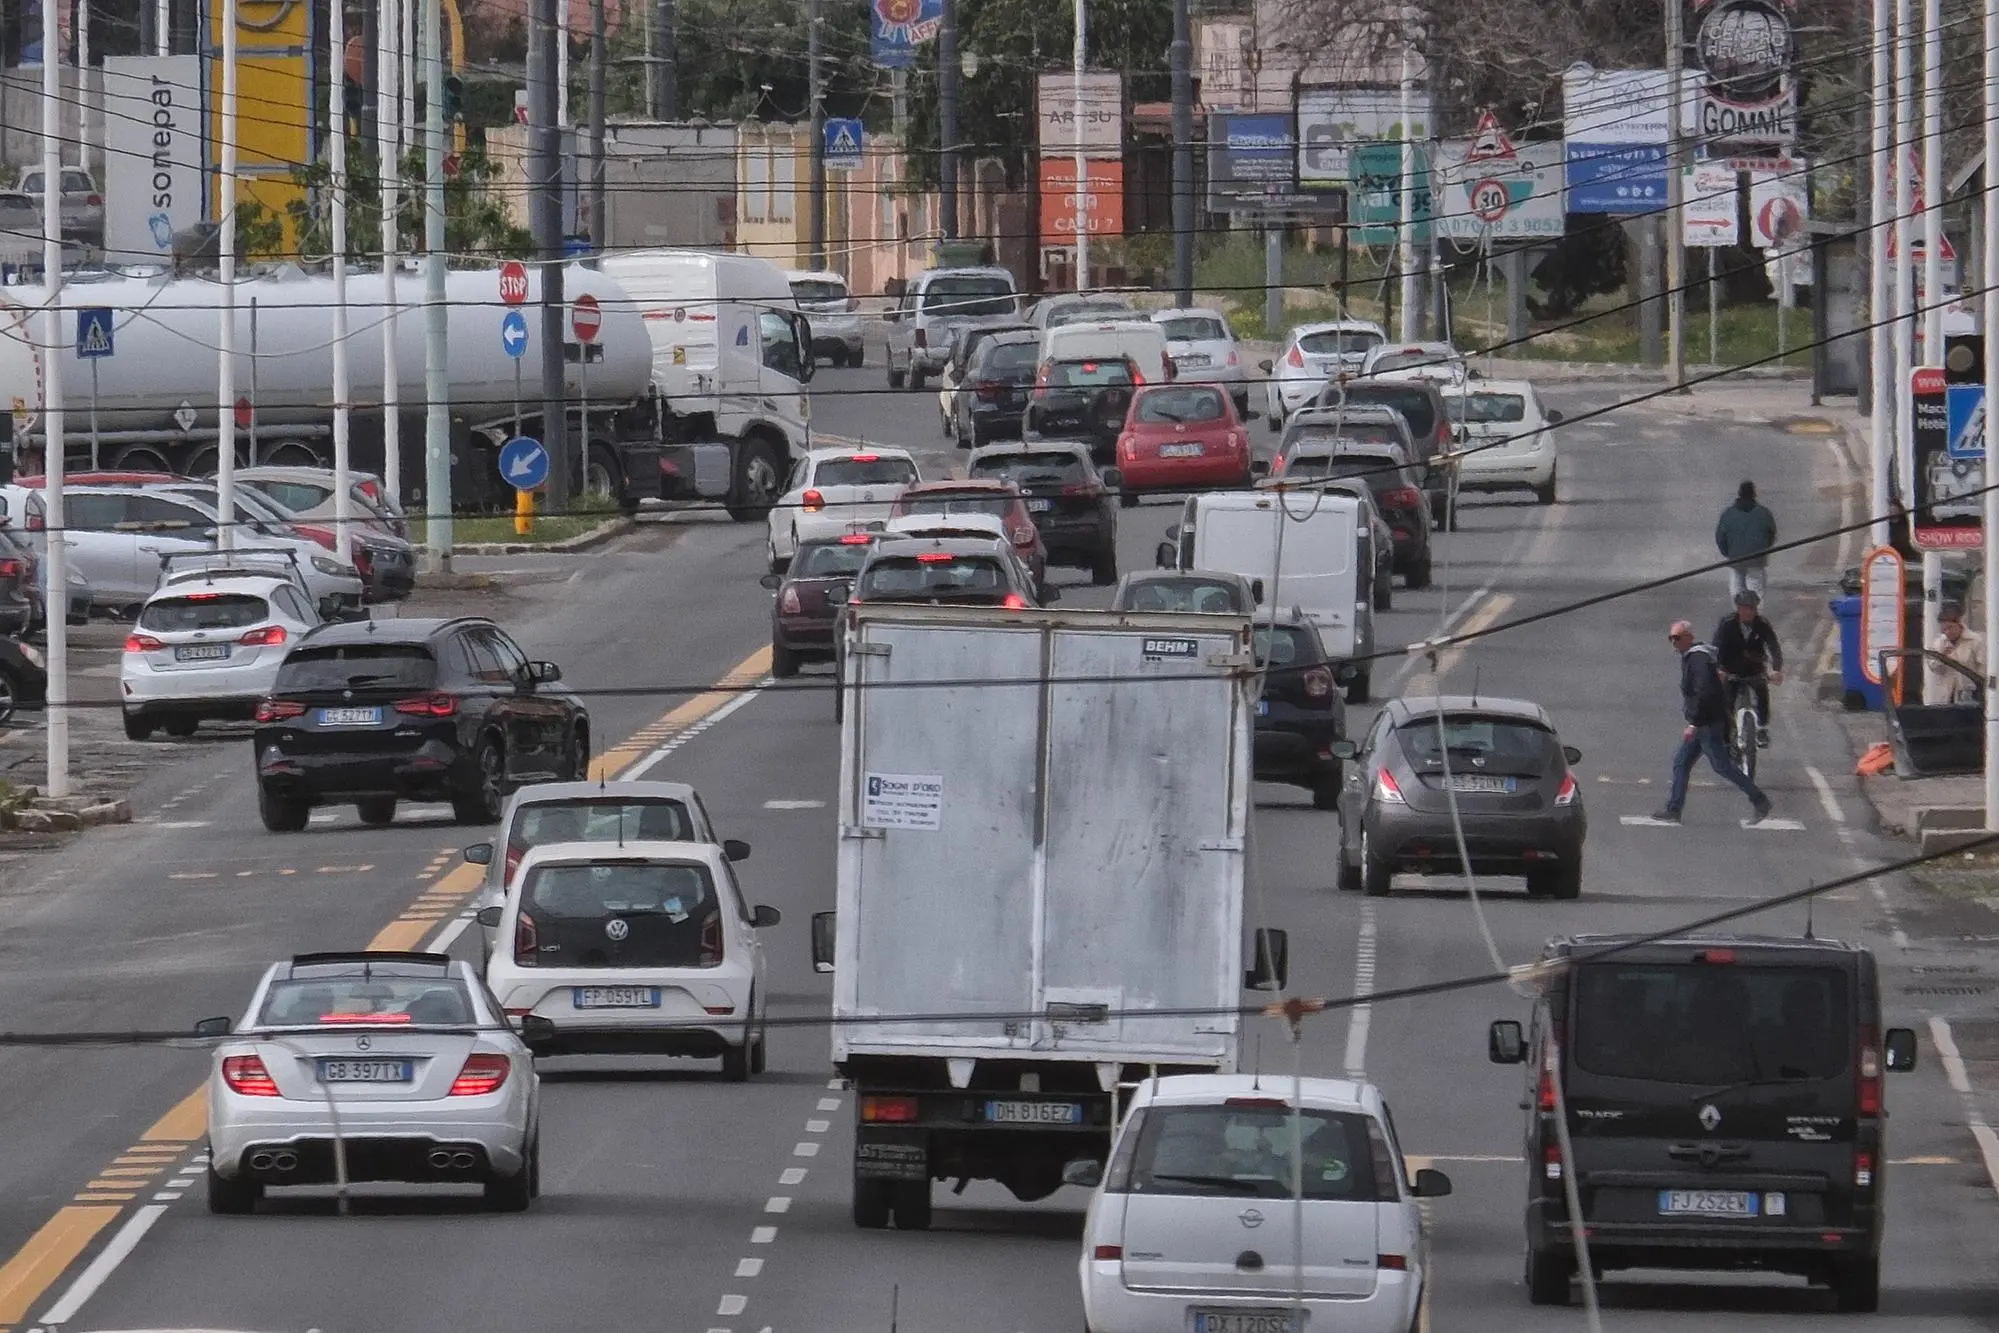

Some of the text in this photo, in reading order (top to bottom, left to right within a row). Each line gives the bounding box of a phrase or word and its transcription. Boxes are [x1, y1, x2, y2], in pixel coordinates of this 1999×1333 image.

[1050, 110, 1112, 124] ARSU
[152, 75, 176, 208] sonepar
[1481, 190, 1501, 207] 30
[1054, 217, 1099, 232] CAU
[501, 275, 526, 296] STOP
[328, 1063, 401, 1079] GB 397TX
[996, 1103, 1016, 1120] DH
[1670, 1193, 1691, 1210] FJ
